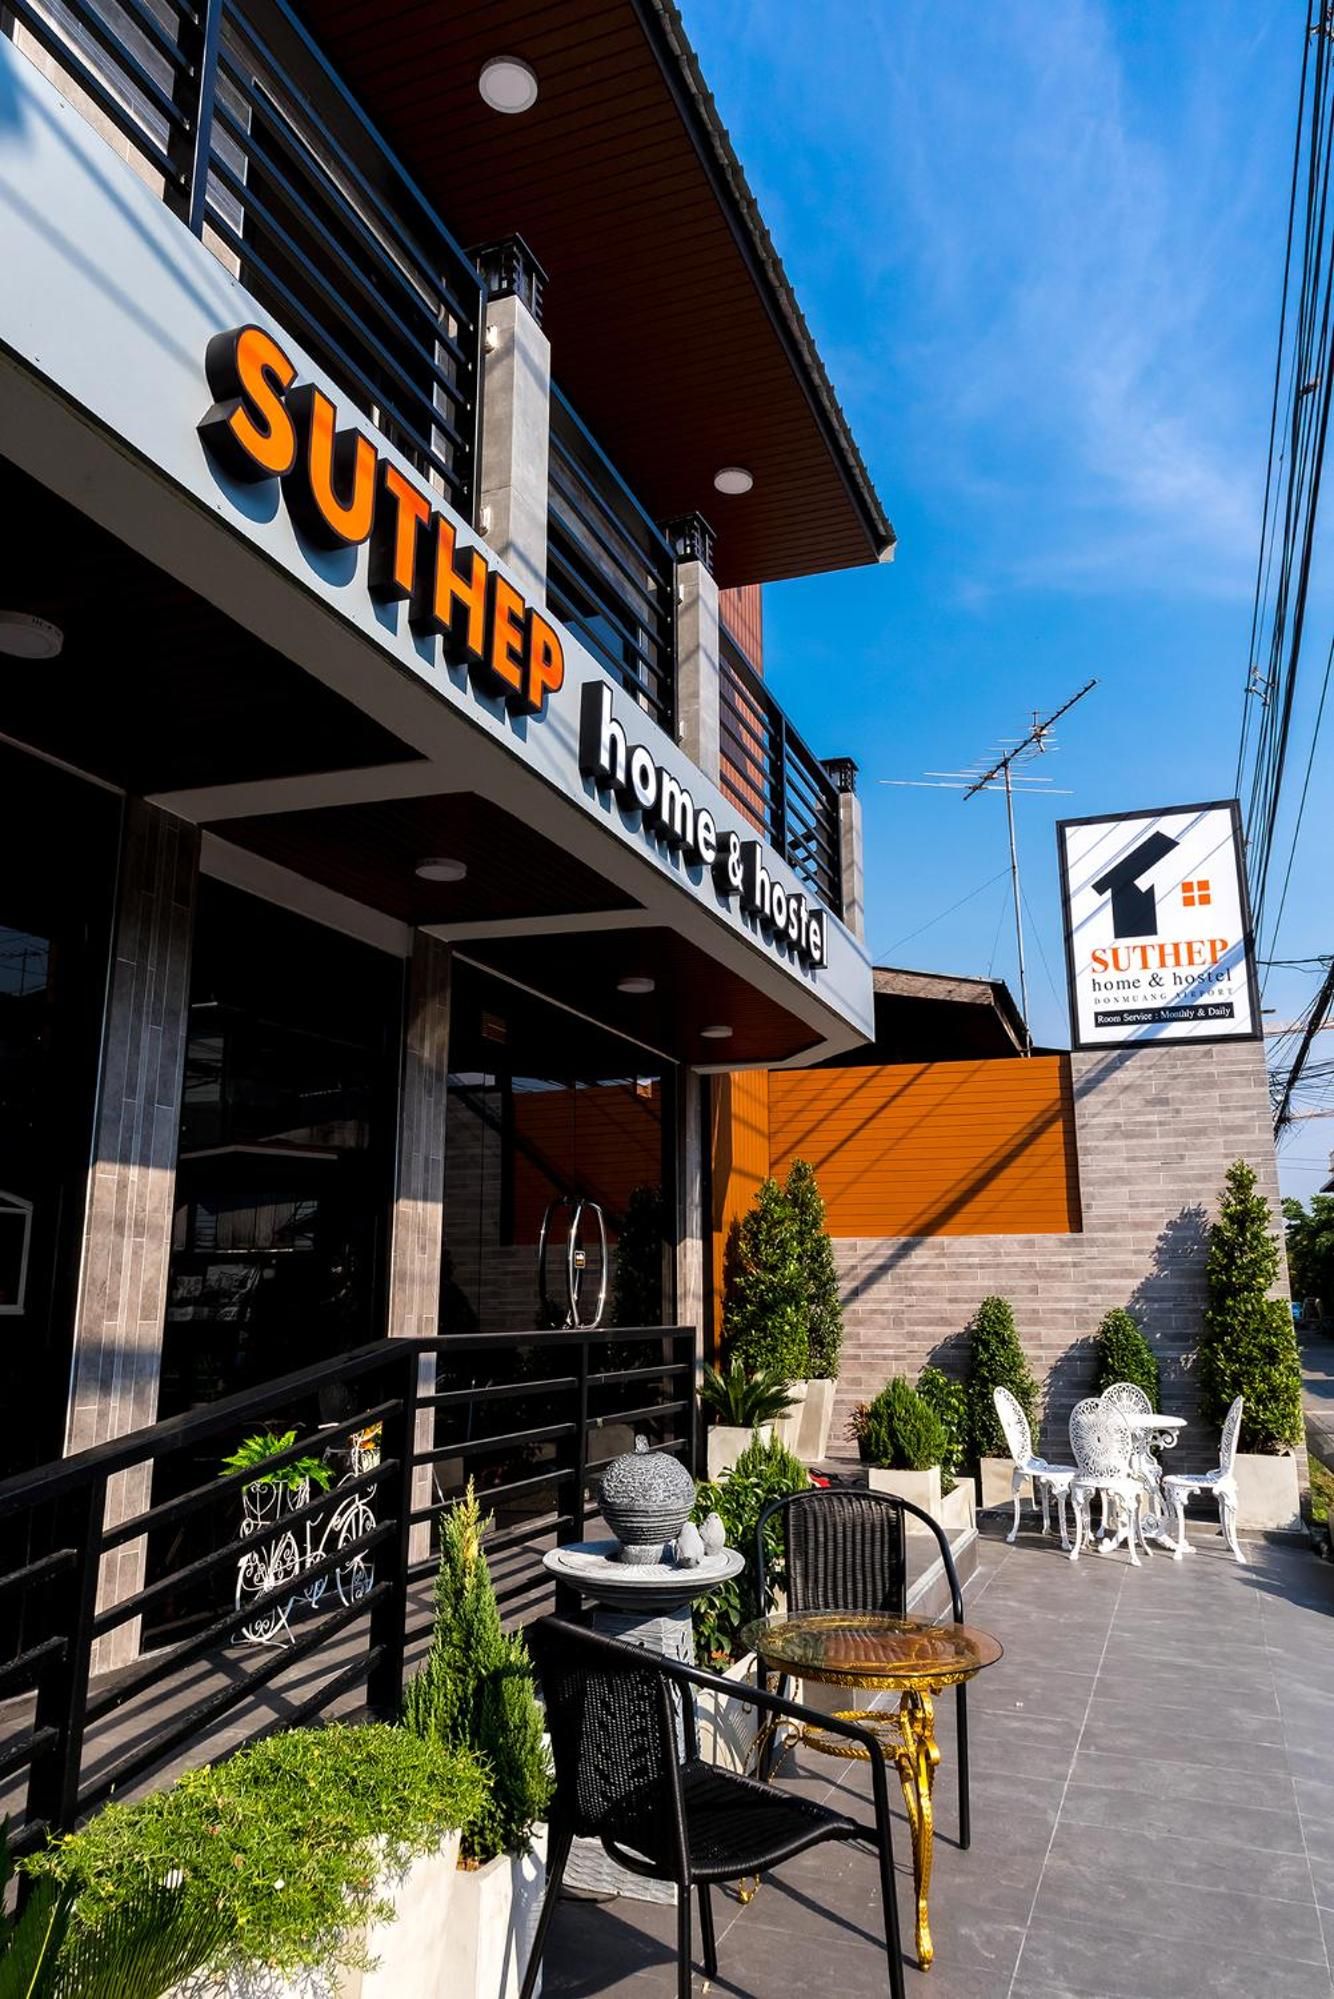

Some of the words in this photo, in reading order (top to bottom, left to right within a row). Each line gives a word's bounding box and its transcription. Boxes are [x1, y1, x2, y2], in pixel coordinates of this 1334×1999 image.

[206, 323, 565, 716] SUTHEP
[592, 679, 717, 866] home
[749, 841, 828, 969] hostel
[1091, 938, 1229, 974] SUTHEP
[1092, 978, 1140, 992] home
[1148, 972, 1164, 988] &
[1173, 968, 1232, 986] hostel
[1094, 993, 1167, 1005] DONMUANG
[1097, 1015, 1121, 1023] Room
[1123, 1011, 1152, 1021] Service
[1160, 1009, 1195, 1019] Monthly
[1197, 1008, 1206, 1016] &
[1208, 1005, 1231, 1016] Daily
